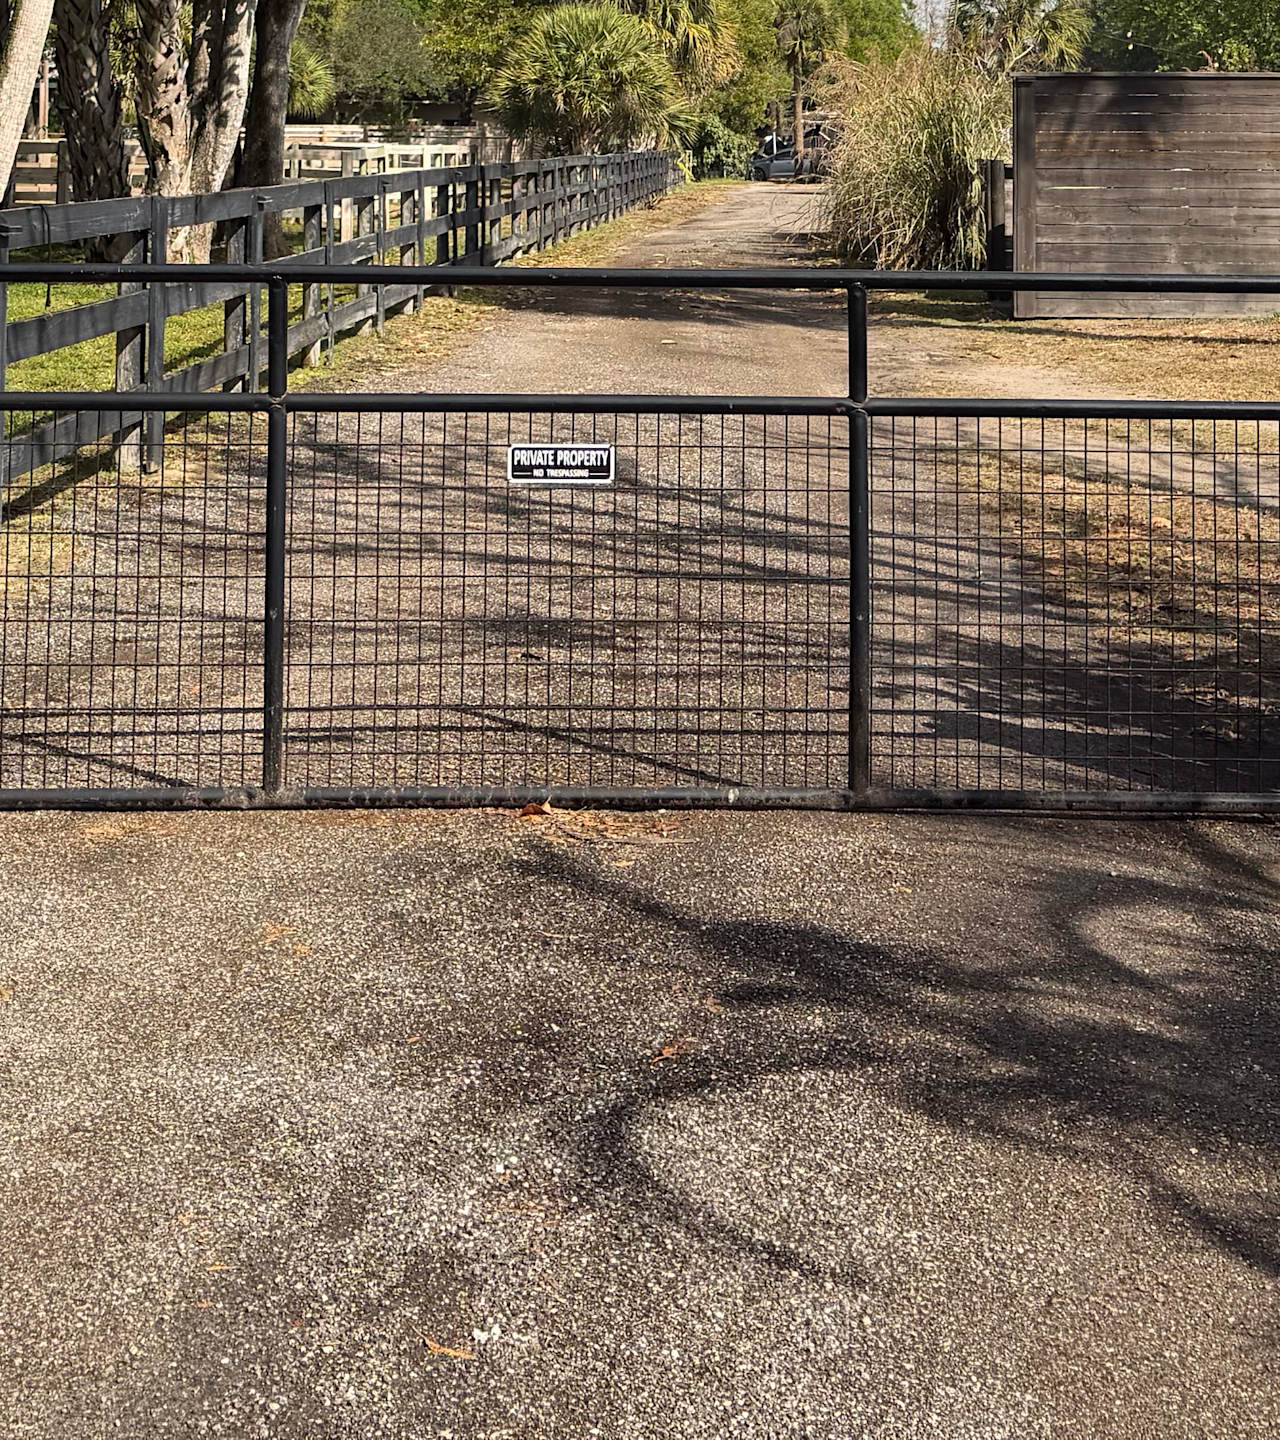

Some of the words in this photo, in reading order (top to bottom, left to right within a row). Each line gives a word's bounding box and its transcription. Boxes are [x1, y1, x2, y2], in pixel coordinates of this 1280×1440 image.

[513, 449, 555, 466] PRIVATE
[556, 449, 609, 466] PROPERTY
[532, 468, 544, 477] NO
[546, 468, 589, 478] TRESPASSING
